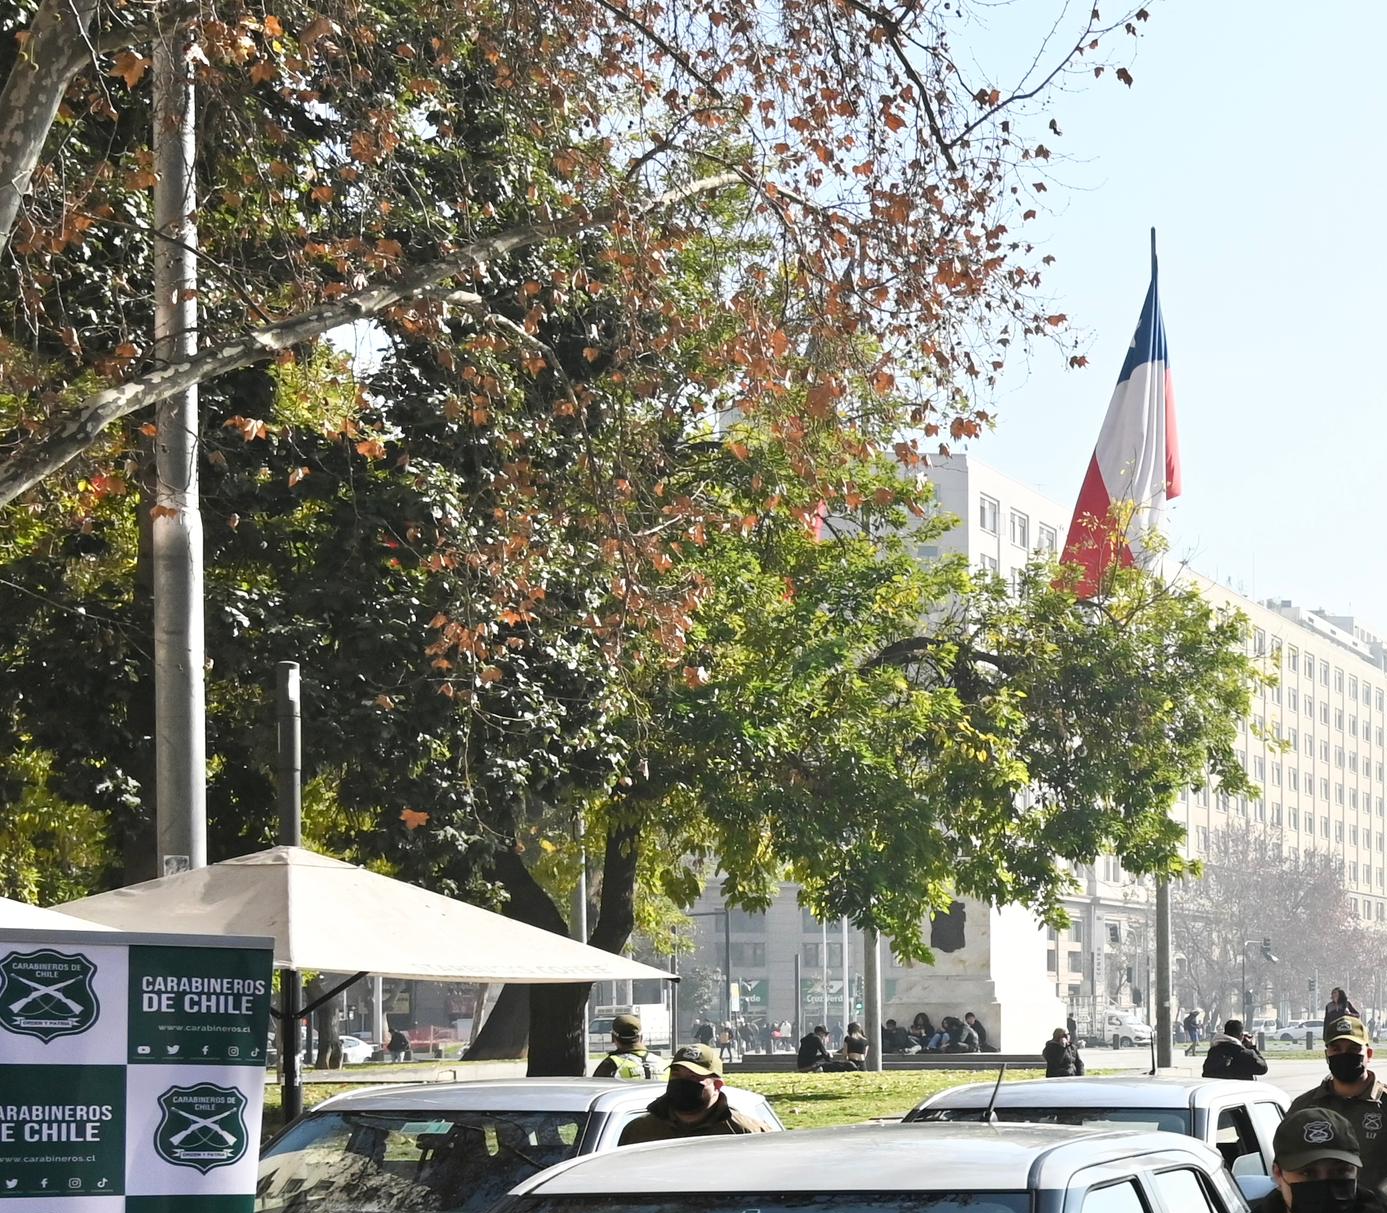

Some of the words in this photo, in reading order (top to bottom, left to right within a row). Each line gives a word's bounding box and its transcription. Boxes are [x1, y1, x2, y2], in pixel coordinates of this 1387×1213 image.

[12, 963, 69, 971] CARABINEROS
[142, 976, 265, 995] CARABINEROS
[142, 993, 175, 1012] DE
[184, 994, 254, 1014] CHILE
[158, 1024, 251, 1033] www.carabineros.cl
[24, 1122, 101, 1142] CHILE
